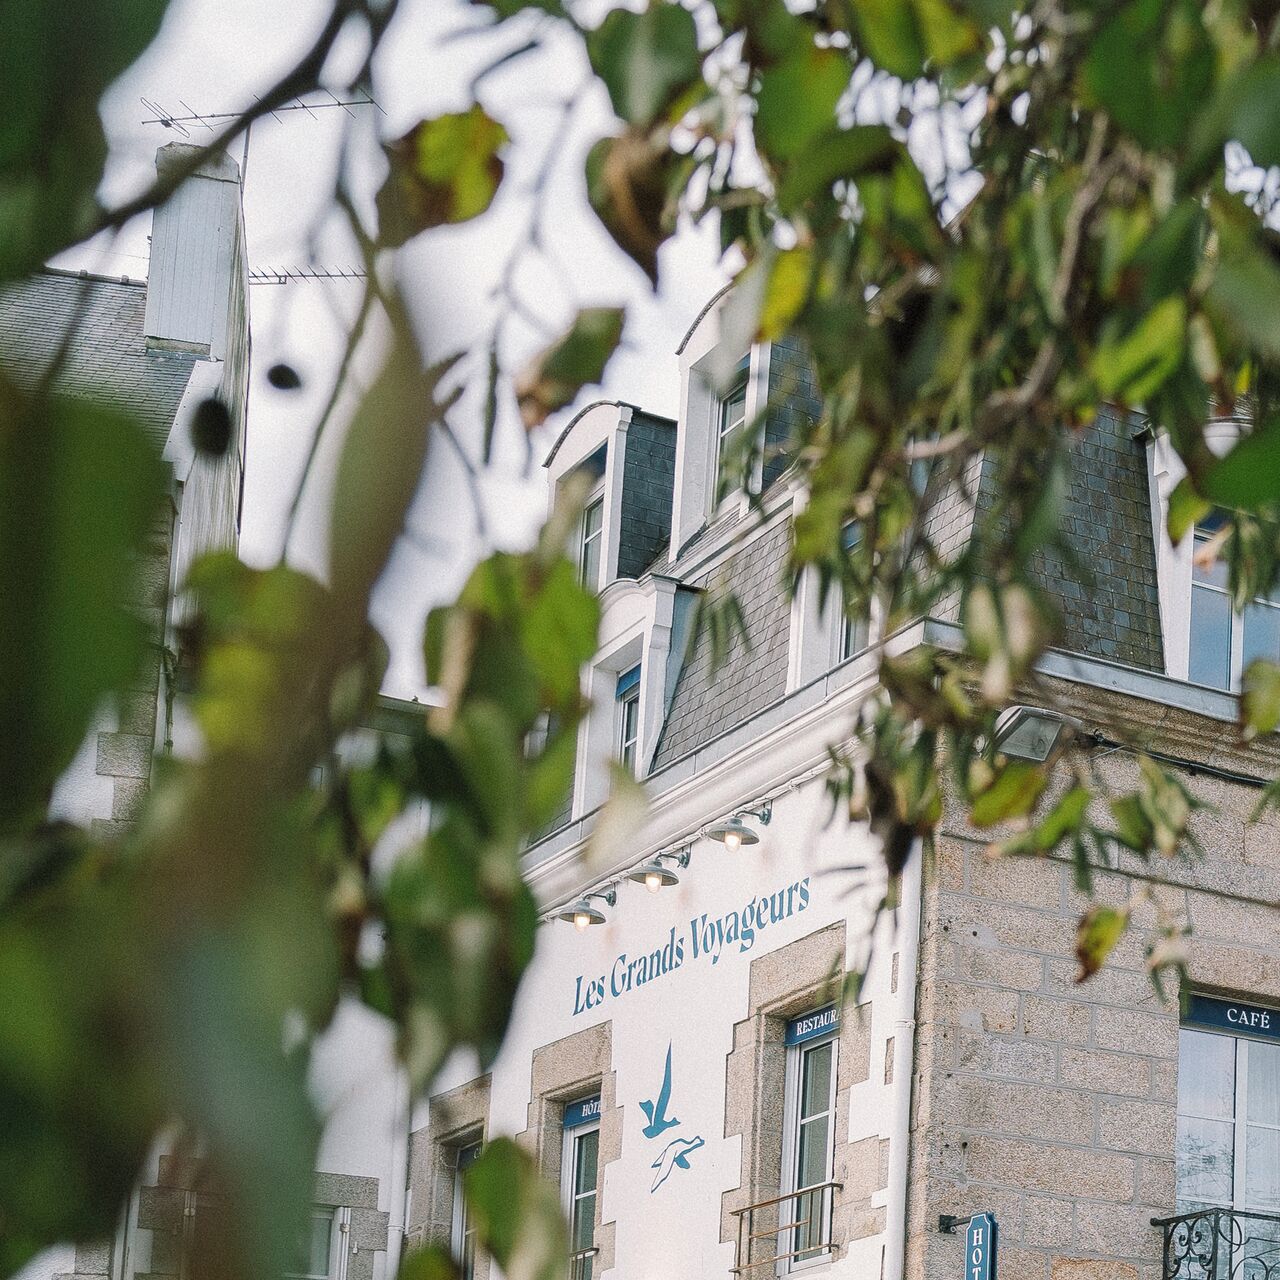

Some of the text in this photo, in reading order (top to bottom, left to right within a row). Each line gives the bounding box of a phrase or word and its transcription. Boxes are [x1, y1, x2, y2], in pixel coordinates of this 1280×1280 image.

[572, 877, 810, 1017] Les Grands Voyageurs
[1227, 1008, 1270, 1029] CAFÉ
